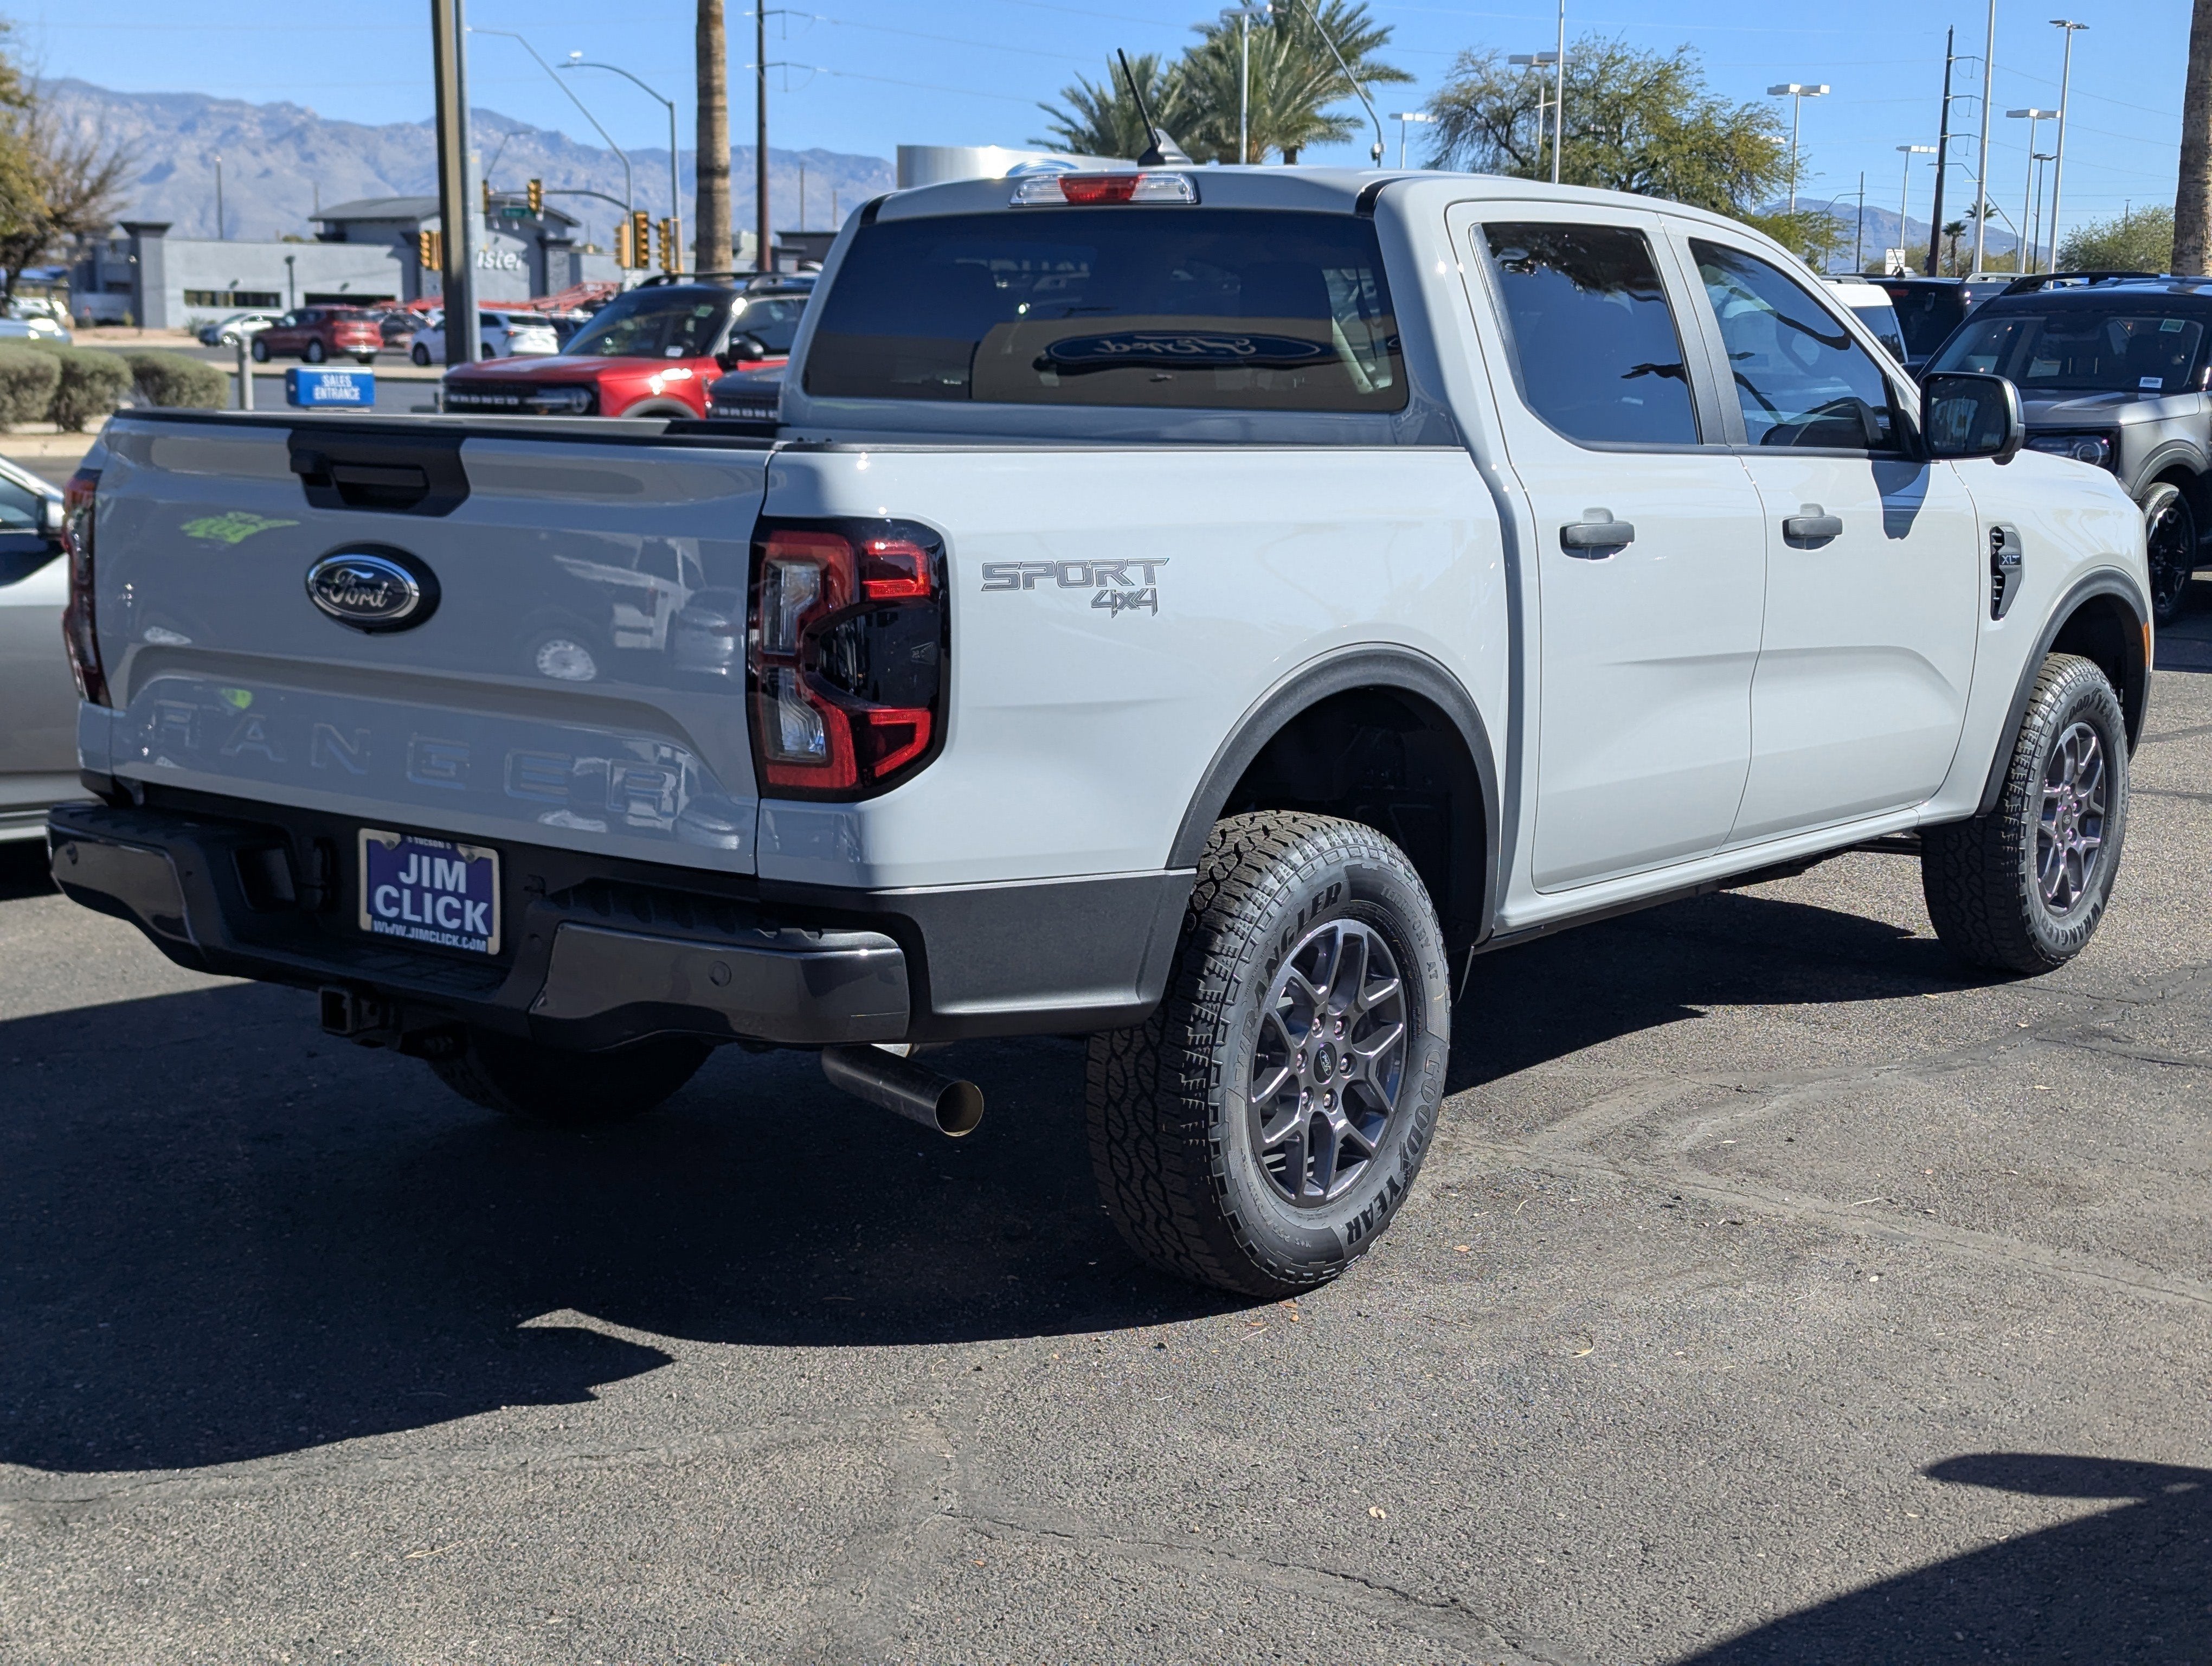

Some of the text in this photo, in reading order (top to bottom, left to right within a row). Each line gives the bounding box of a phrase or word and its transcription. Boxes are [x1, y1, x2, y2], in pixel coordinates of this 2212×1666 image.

[314, 386, 361, 400] ENTRANCE
[321, 374, 352, 387] SALES
[449, 394, 519, 405] BRONCO
[718, 407, 779, 418] BRONC
[981, 558, 1170, 592] SPORT
[2001, 555, 2020, 565] XLT
[320, 568, 393, 607] Ford
[1090, 587, 1159, 619] 4x4
[2061, 687, 2119, 734] GOODYEAR
[151, 699, 681, 818] RANGER
[414, 836, 445, 849] TUCSON
[398, 853, 466, 894] JIM
[375, 885, 488, 935] CLICK
[2041, 901, 2101, 946] WRANGLER
[374, 920, 486, 952] WWW.JIMCLICK.COM
[1380, 885, 1439, 981] TERRITORY AT
[1234, 881, 1342, 1082] WRANGLER
[1345, 1050, 1443, 1246] GOODYEAR
